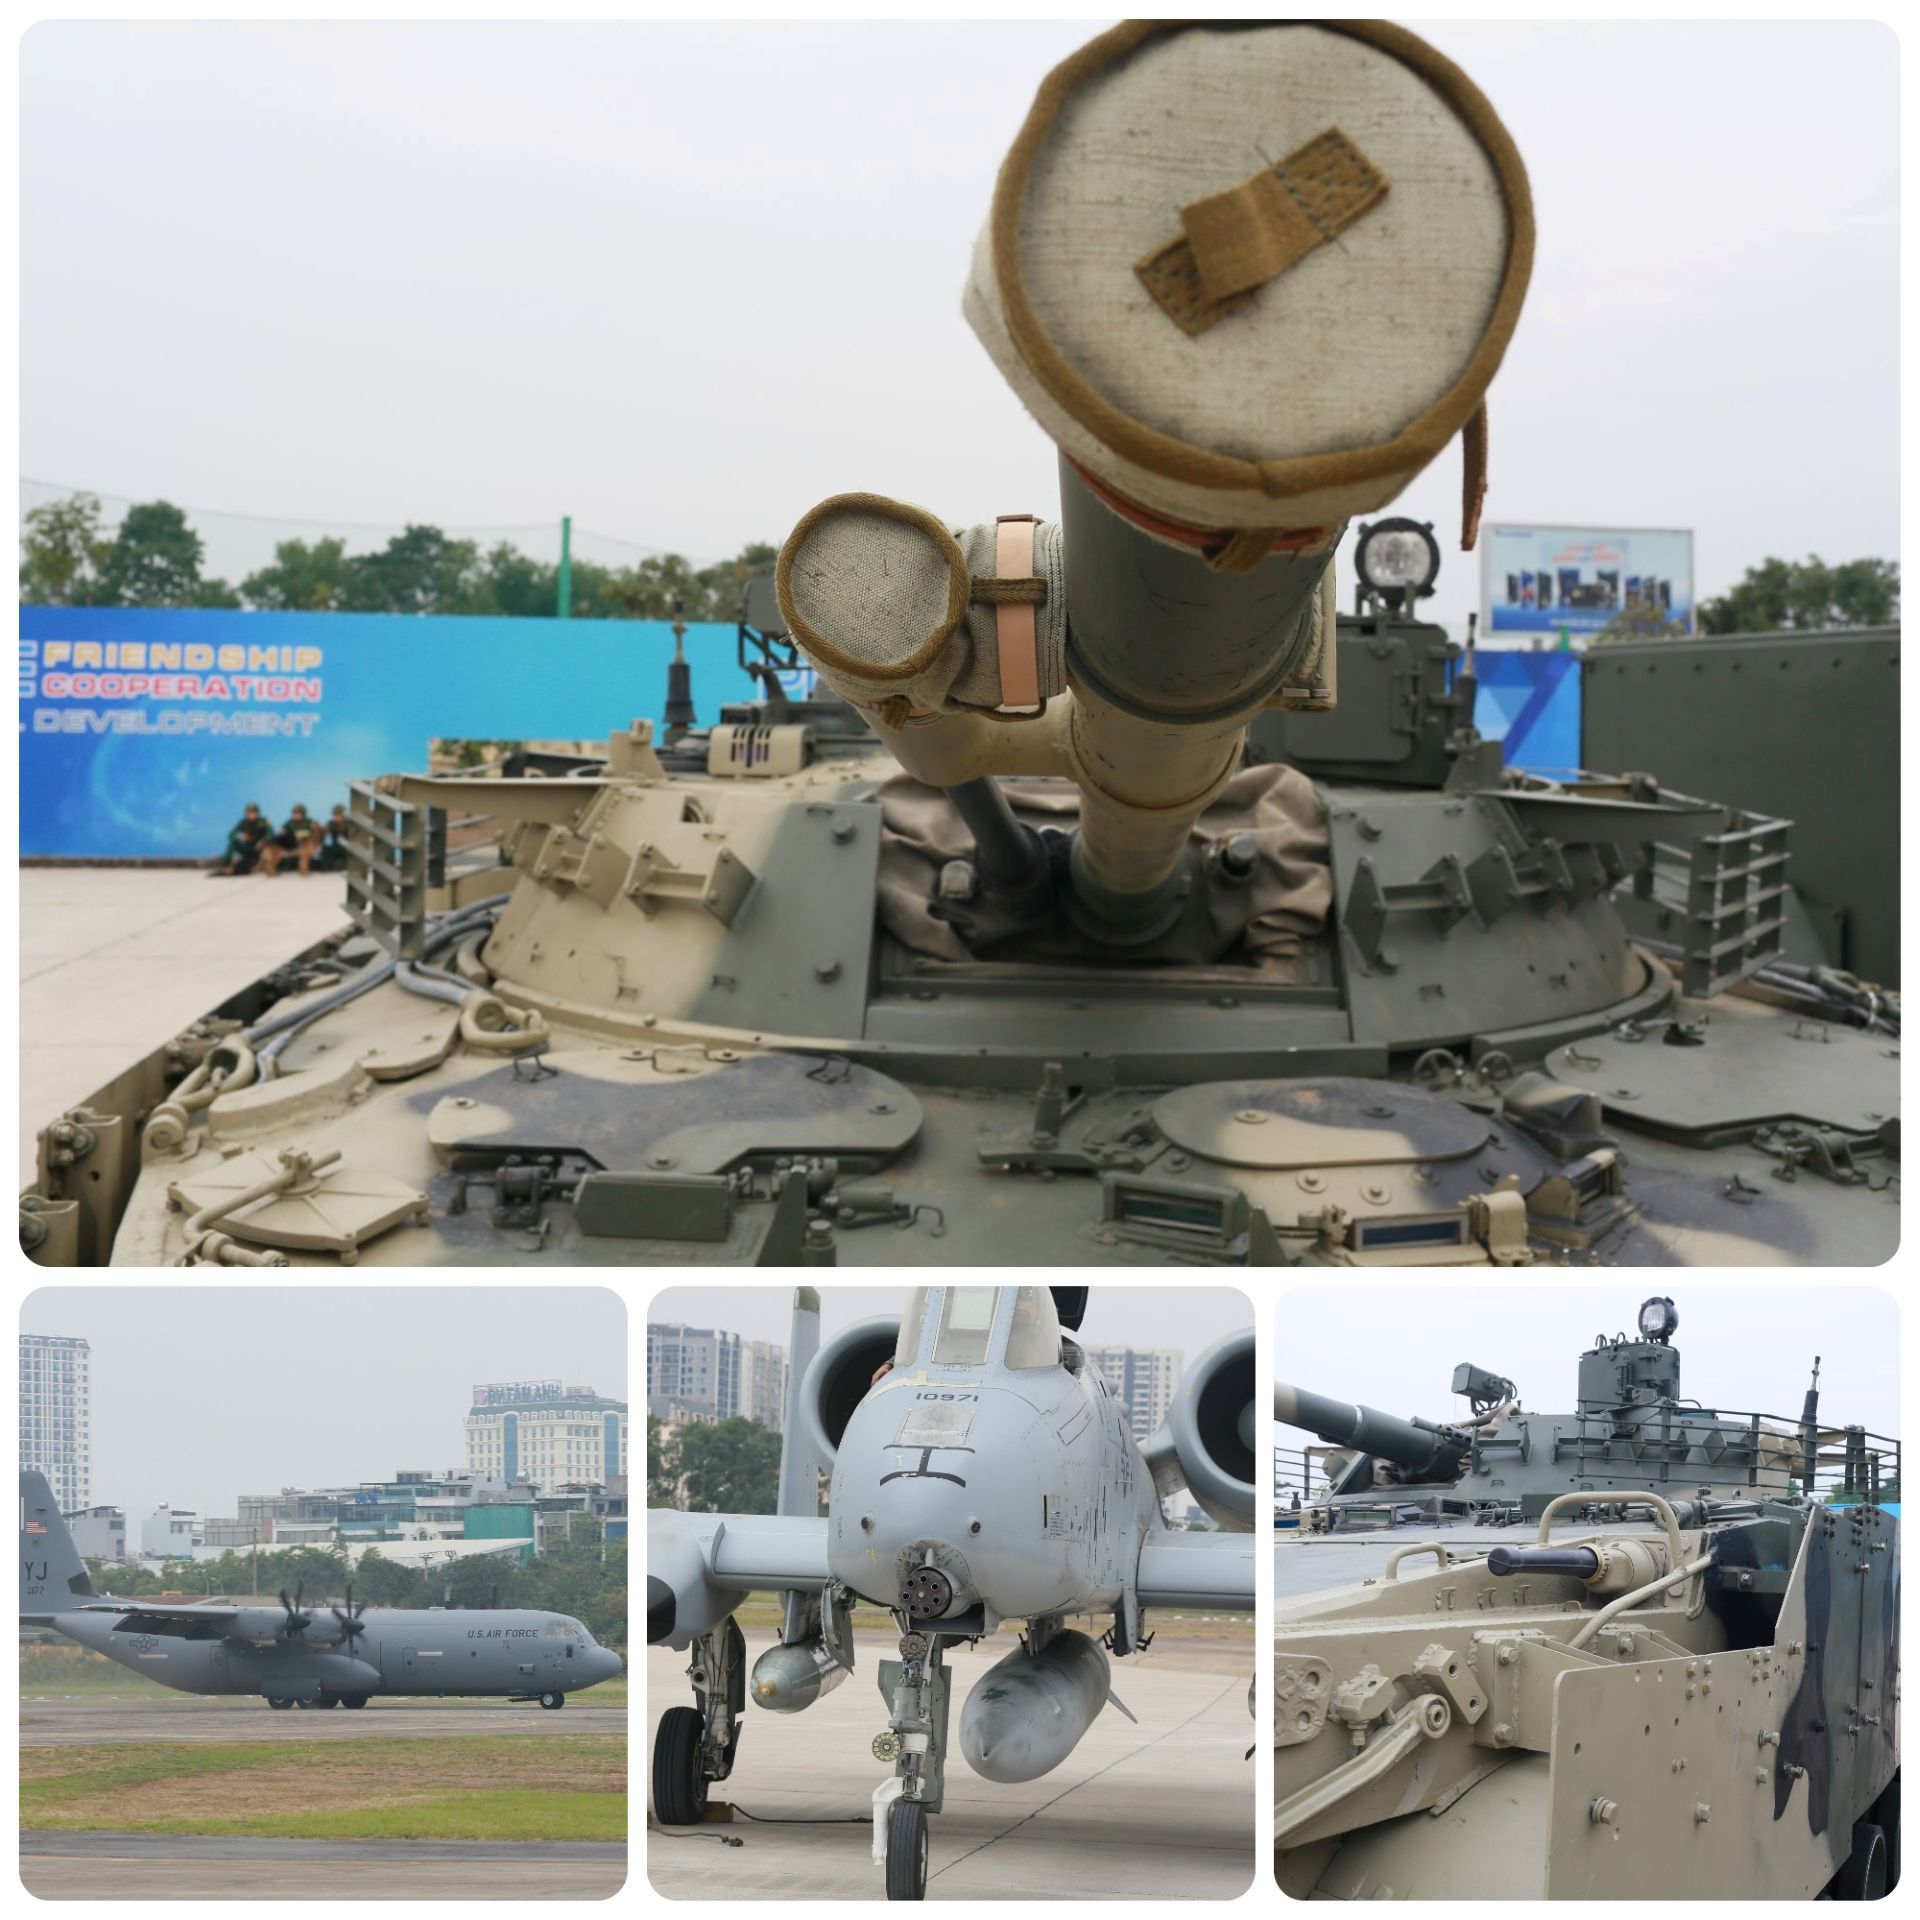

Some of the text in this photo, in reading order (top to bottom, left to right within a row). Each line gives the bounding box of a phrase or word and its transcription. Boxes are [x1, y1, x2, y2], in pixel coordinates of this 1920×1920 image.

[43, 641, 322, 672] FRIENDSHIP
[41, 672, 322, 702] COOPERATION
[33, 708, 320, 737] DEVELOPMENT
[916, 1392, 979, 1402] 10971
[24, 1561, 48, 1581] YJ
[505, 1629, 539, 1639] FORCE
